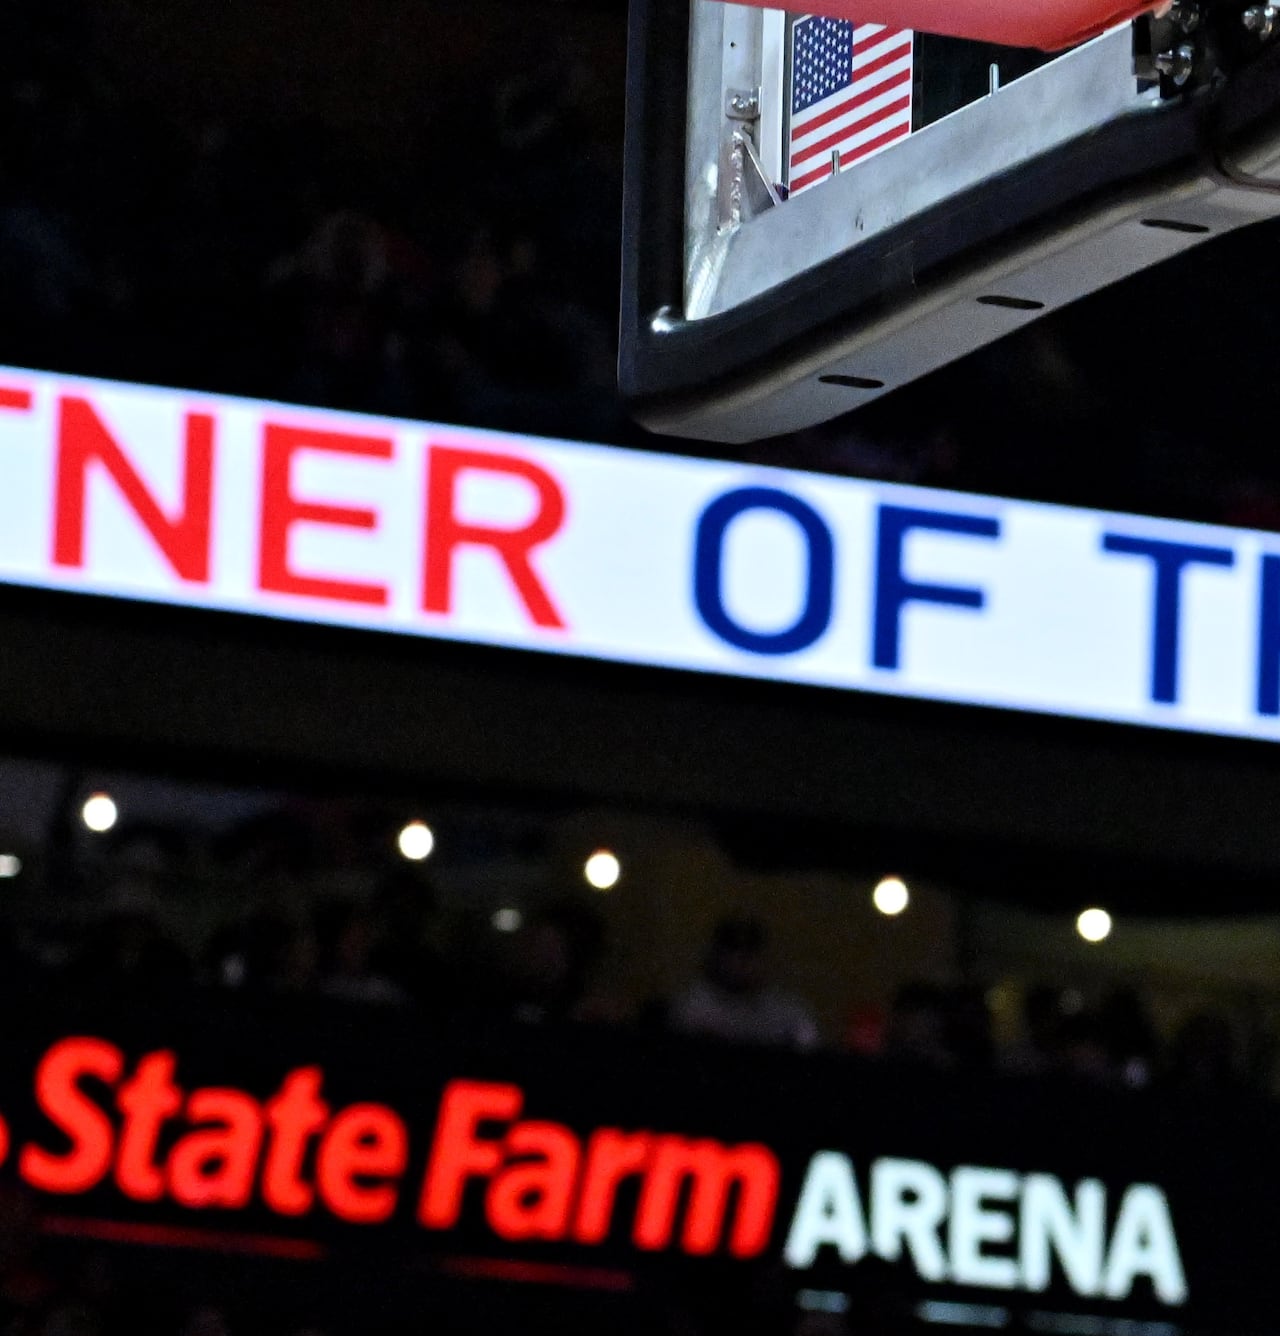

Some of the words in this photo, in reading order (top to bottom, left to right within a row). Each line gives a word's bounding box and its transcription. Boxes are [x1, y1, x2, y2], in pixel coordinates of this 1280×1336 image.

[694, 486, 1001, 669] OF
[19, 1035, 407, 1224] State
[416, 1078, 780, 1260] Farm
[783, 1150, 1188, 1305] ARENA
